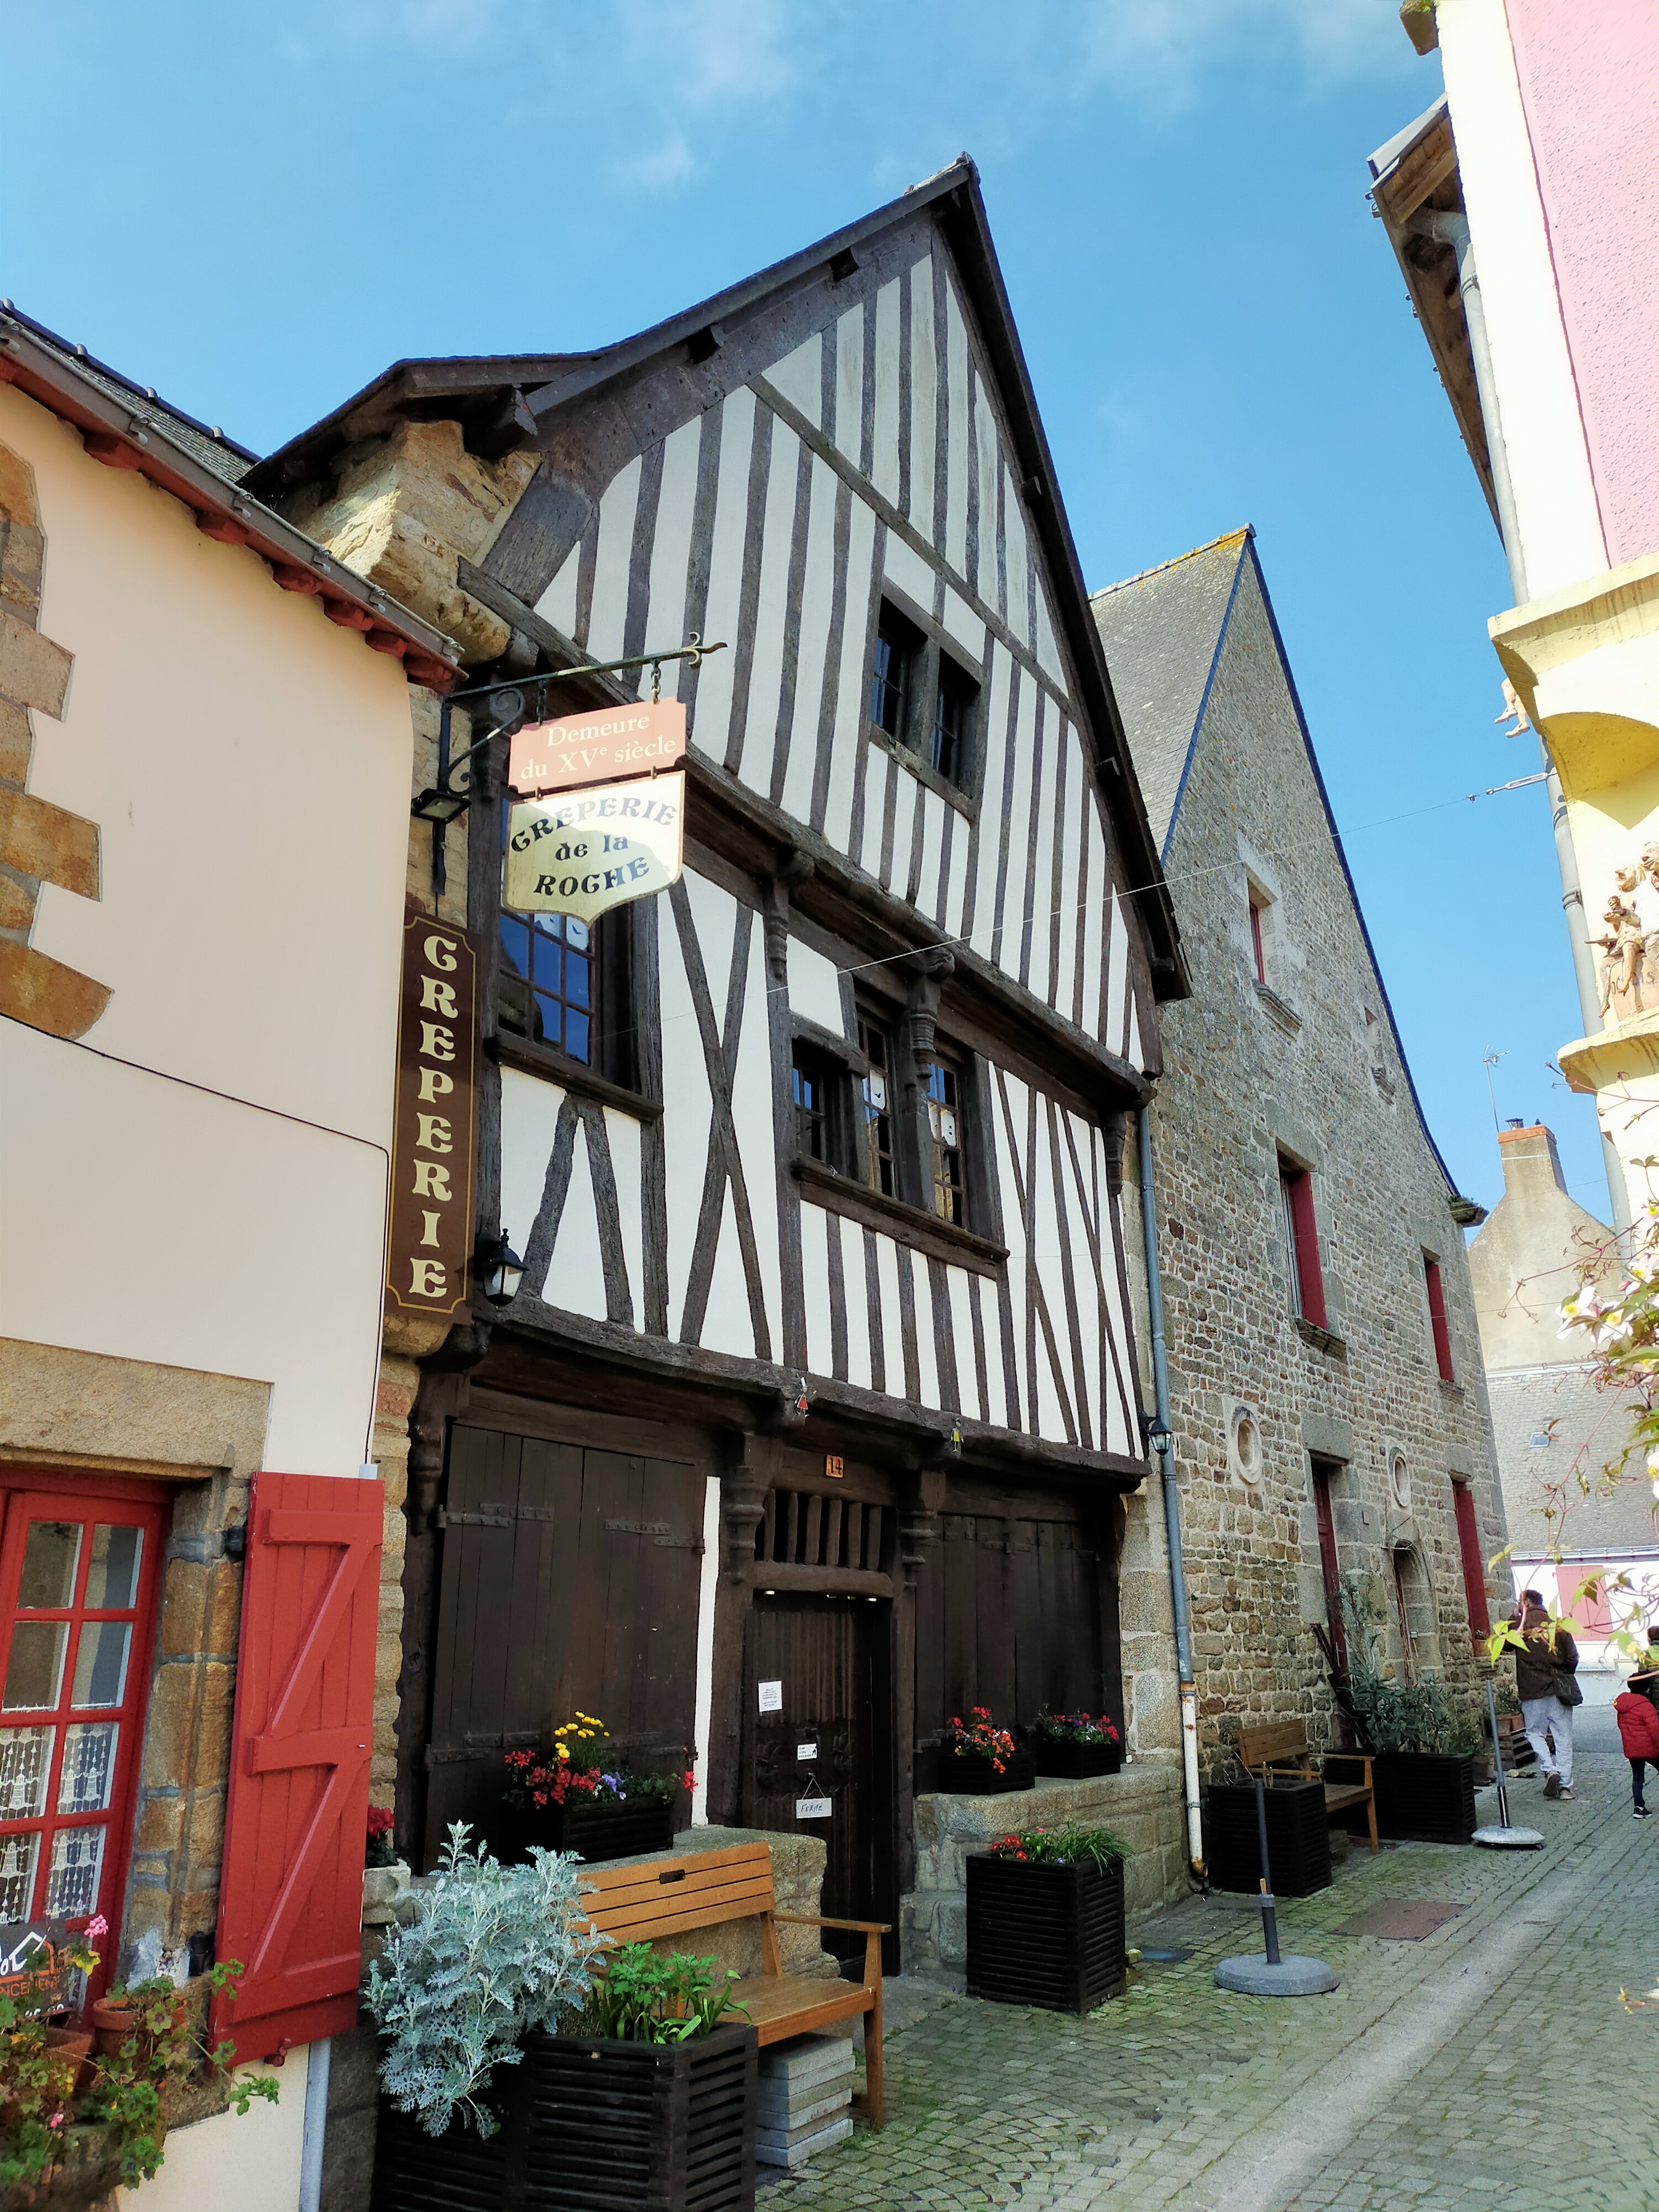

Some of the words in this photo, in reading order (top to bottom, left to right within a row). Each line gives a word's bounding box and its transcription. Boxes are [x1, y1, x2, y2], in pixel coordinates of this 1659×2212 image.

[546, 716, 649, 747] Demeure
[520, 758, 547, 780] du
[614, 734, 676, 763] siècle
[510, 797, 677, 853] CREPERIE
[555, 842, 588, 862] de
[603, 834, 629, 854] la
[533, 857, 650, 897] ROCHE
[409, 935, 458, 1299] CREPERIE
[830, 1457, 842, 1475] 14
